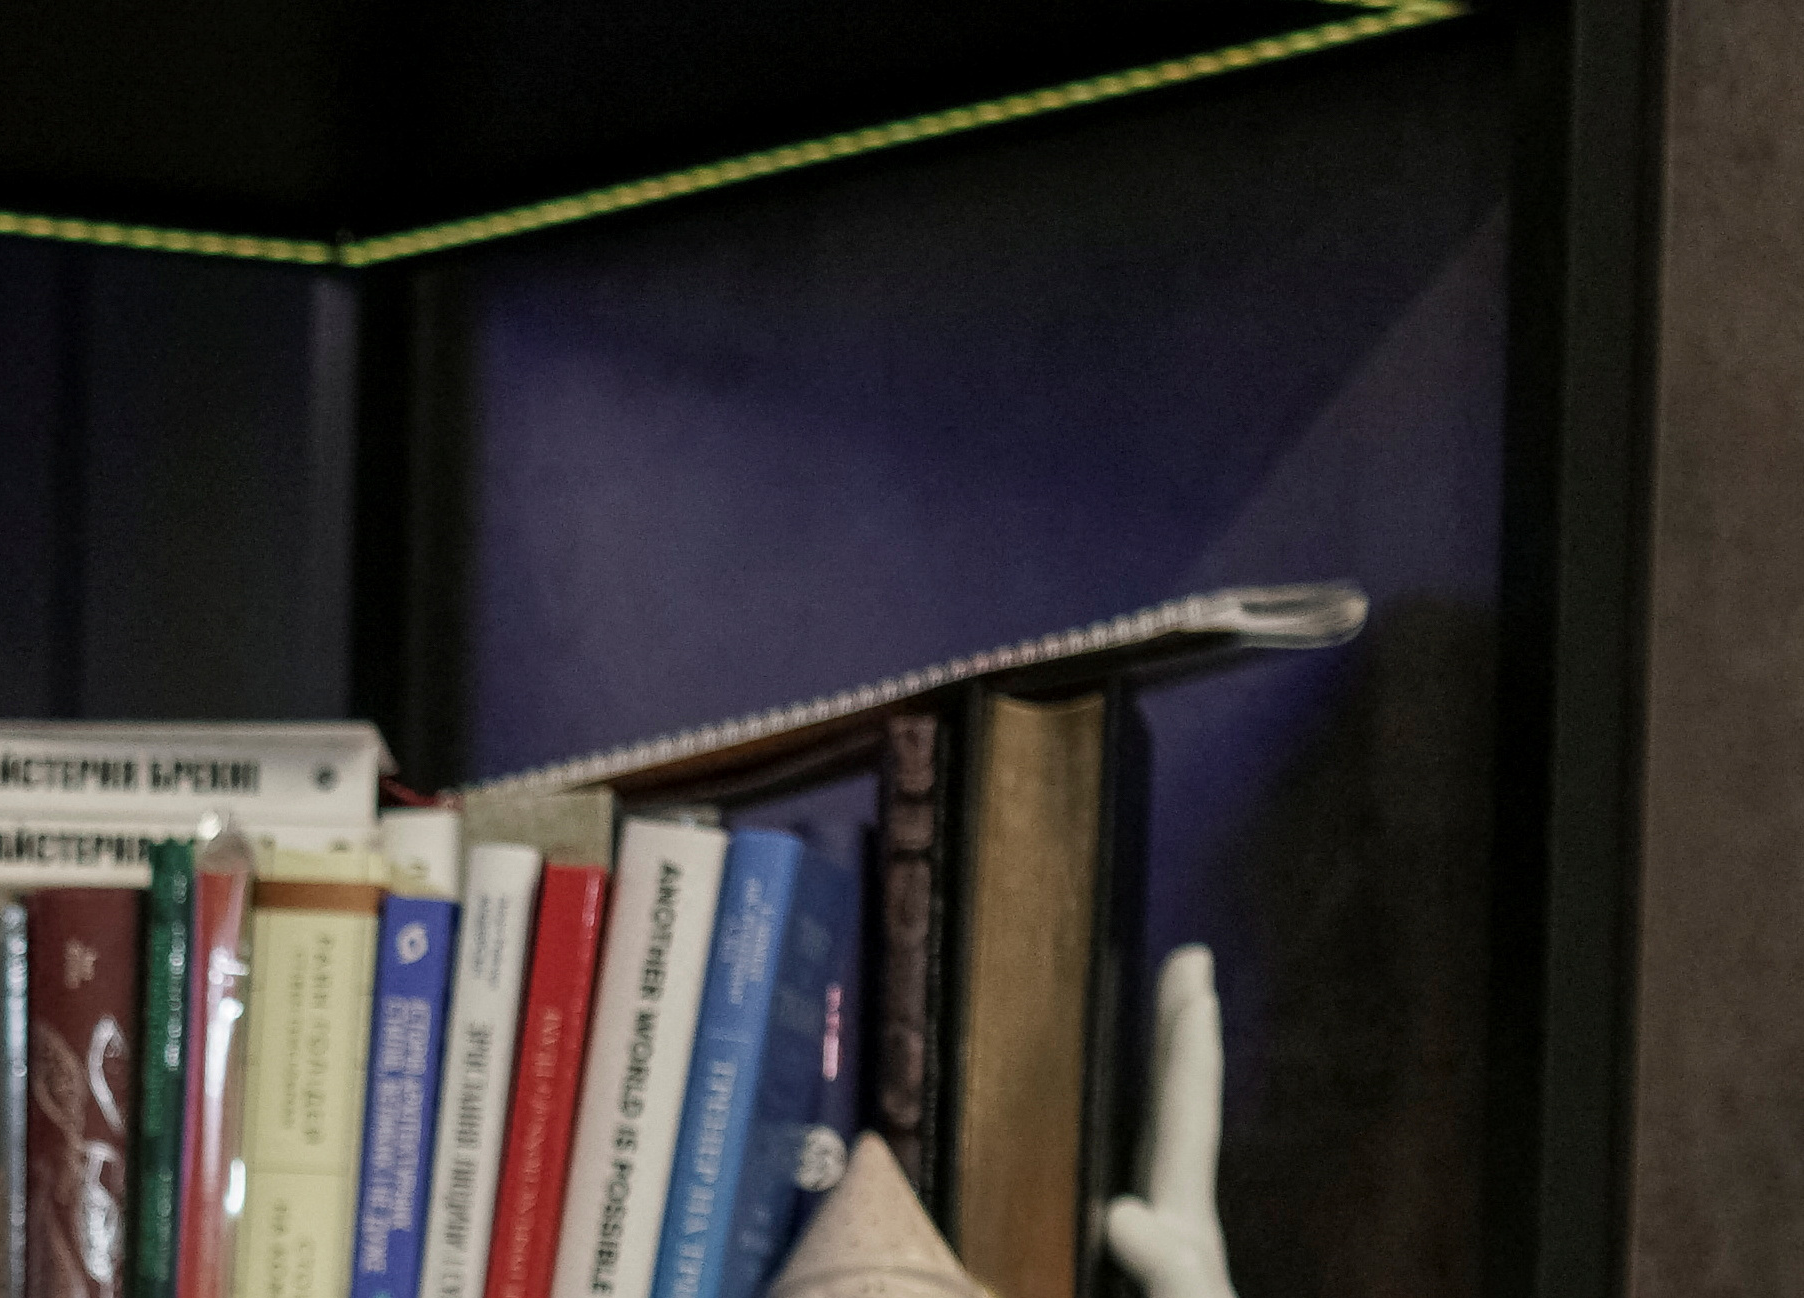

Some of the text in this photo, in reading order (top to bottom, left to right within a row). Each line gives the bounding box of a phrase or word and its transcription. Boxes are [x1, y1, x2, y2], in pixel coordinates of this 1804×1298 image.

[589, 858, 683, 1298] ANOTHER WORLD IS POSSIBLE
[693, 1059, 738, 1185] ТРЕНЕР
[682, 1186, 715, 1236] НА
